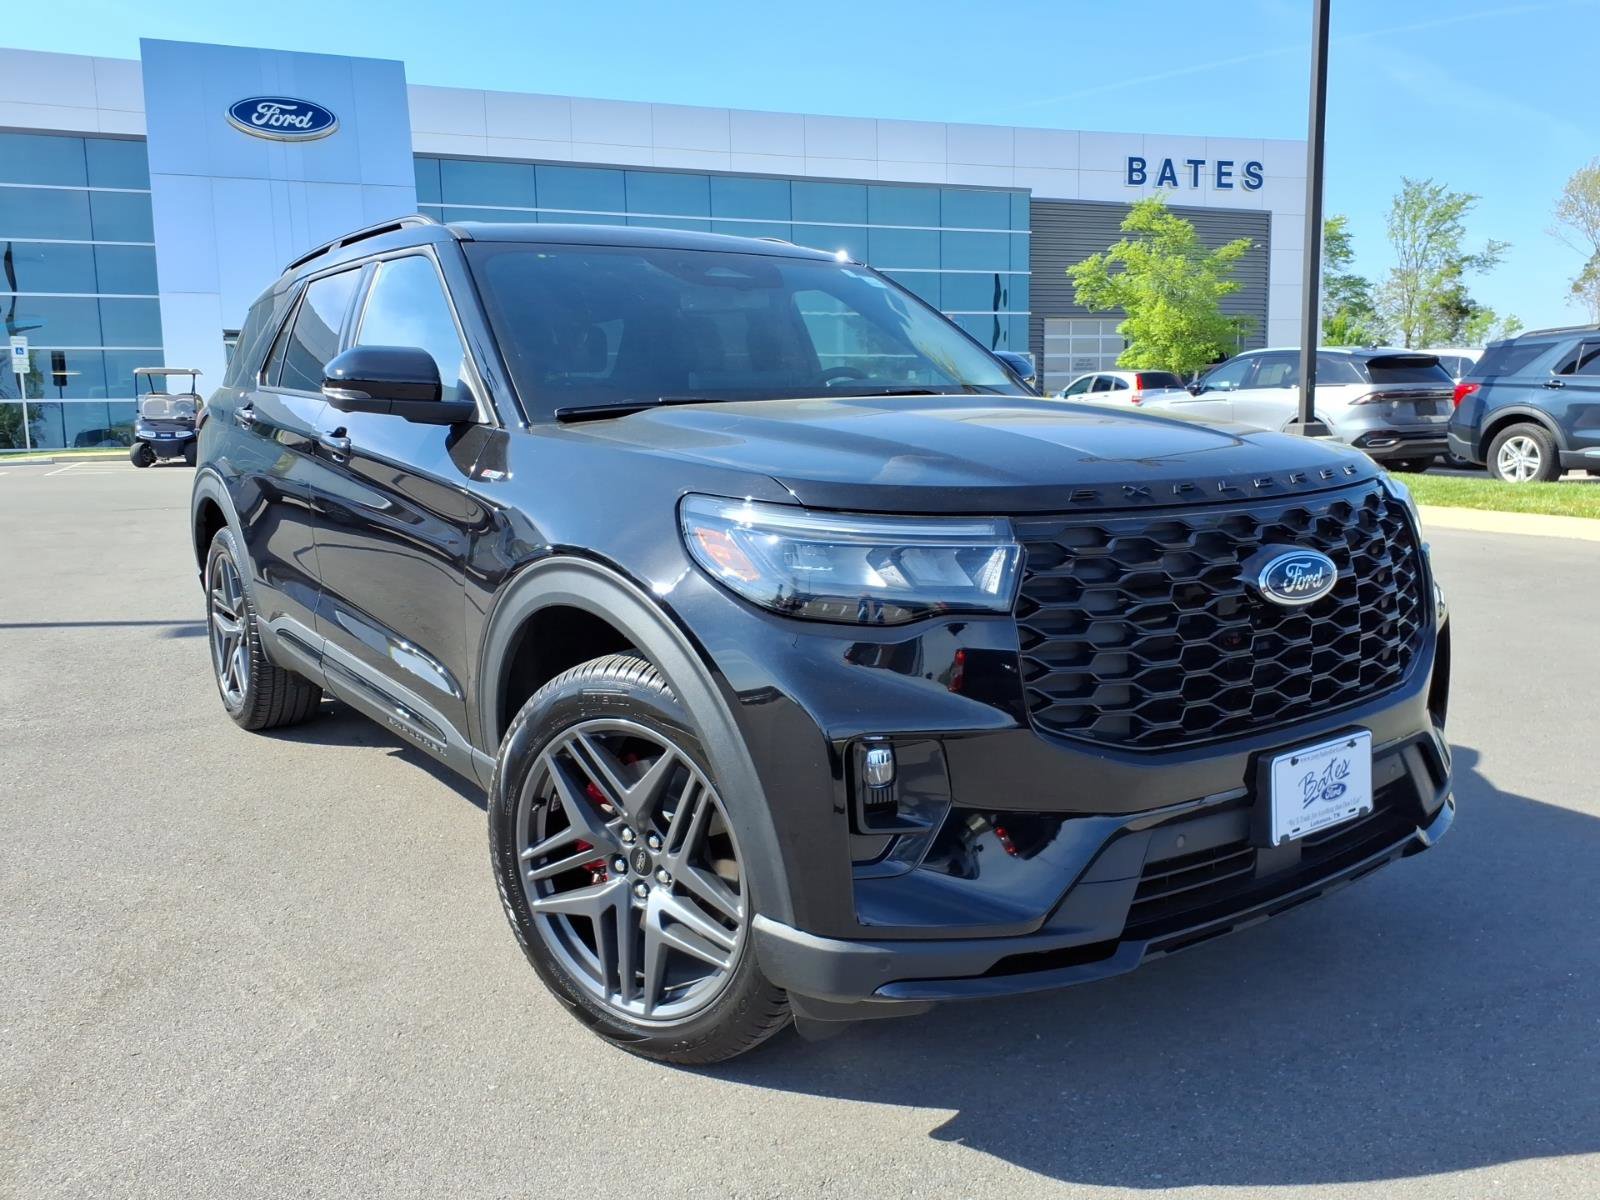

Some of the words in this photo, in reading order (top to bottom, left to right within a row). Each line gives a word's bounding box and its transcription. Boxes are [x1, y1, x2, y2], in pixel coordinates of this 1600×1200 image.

[251, 102, 313, 128] Ford
[1127, 156, 1264, 190] BATES
[1068, 464, 1357, 502] EXPLORER
[1299, 757, 1350, 805] Bates
